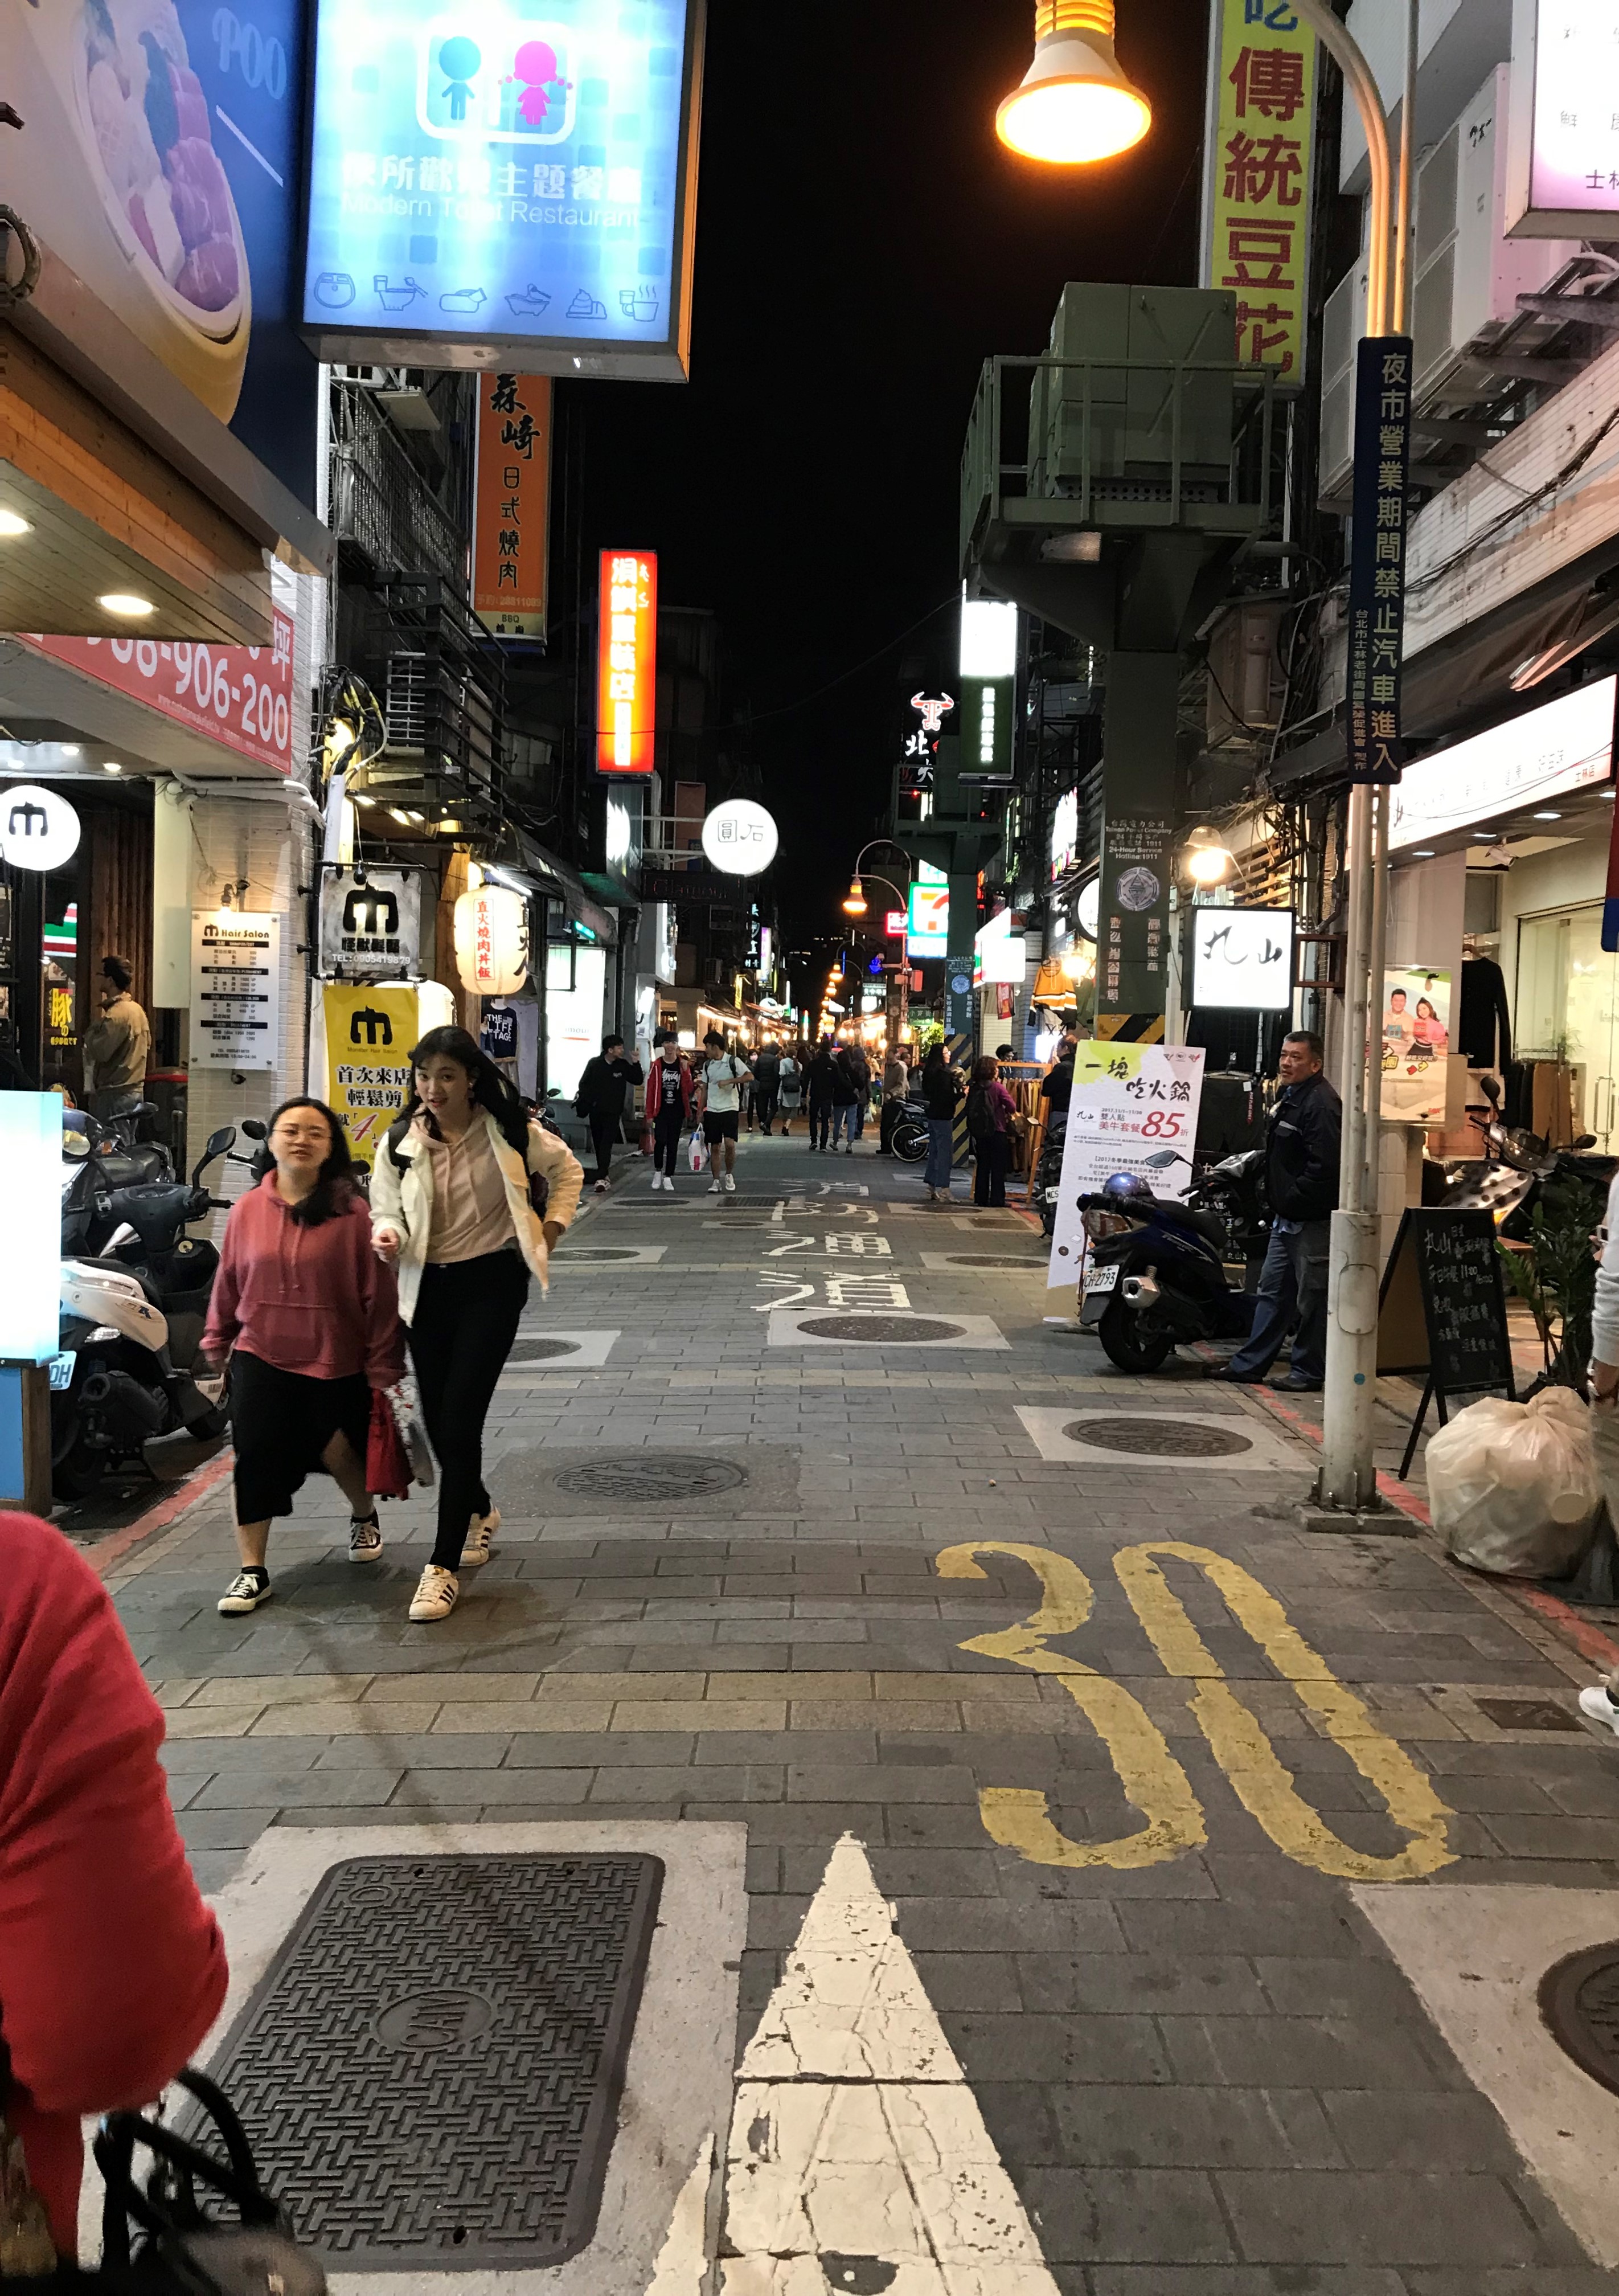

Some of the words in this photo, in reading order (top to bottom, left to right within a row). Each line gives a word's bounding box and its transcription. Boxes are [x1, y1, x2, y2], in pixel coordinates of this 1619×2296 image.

[343, 196, 432, 218] Modern
[442, 198, 502, 221] Toet
[510, 200, 638, 228] Restaurant
[1222, 47, 1305, 373] 傳統豆花
[498, 466, 521, 589] 日式燒肉
[1371, 353, 1407, 771] 夜市營業期間禁止汽車進入
[502, 614, 519, 623] BBQ
[477, 901, 491, 979] 直火燒肉丼飯
[486, 1013, 503, 1022] THE
[487, 1021, 512, 1034] LIFE
[338, 1066, 411, 1084] 首次來店
[348, 1088, 403, 1108] 輕鬆剪
[1126, 1077, 1191, 1102] 吃火鍋
[1099, 1121, 1141, 1133] 美牛套餐
[1082, 1272, 1116, 1288] CH-2793
[936, 1541, 1461, 1881] 30
